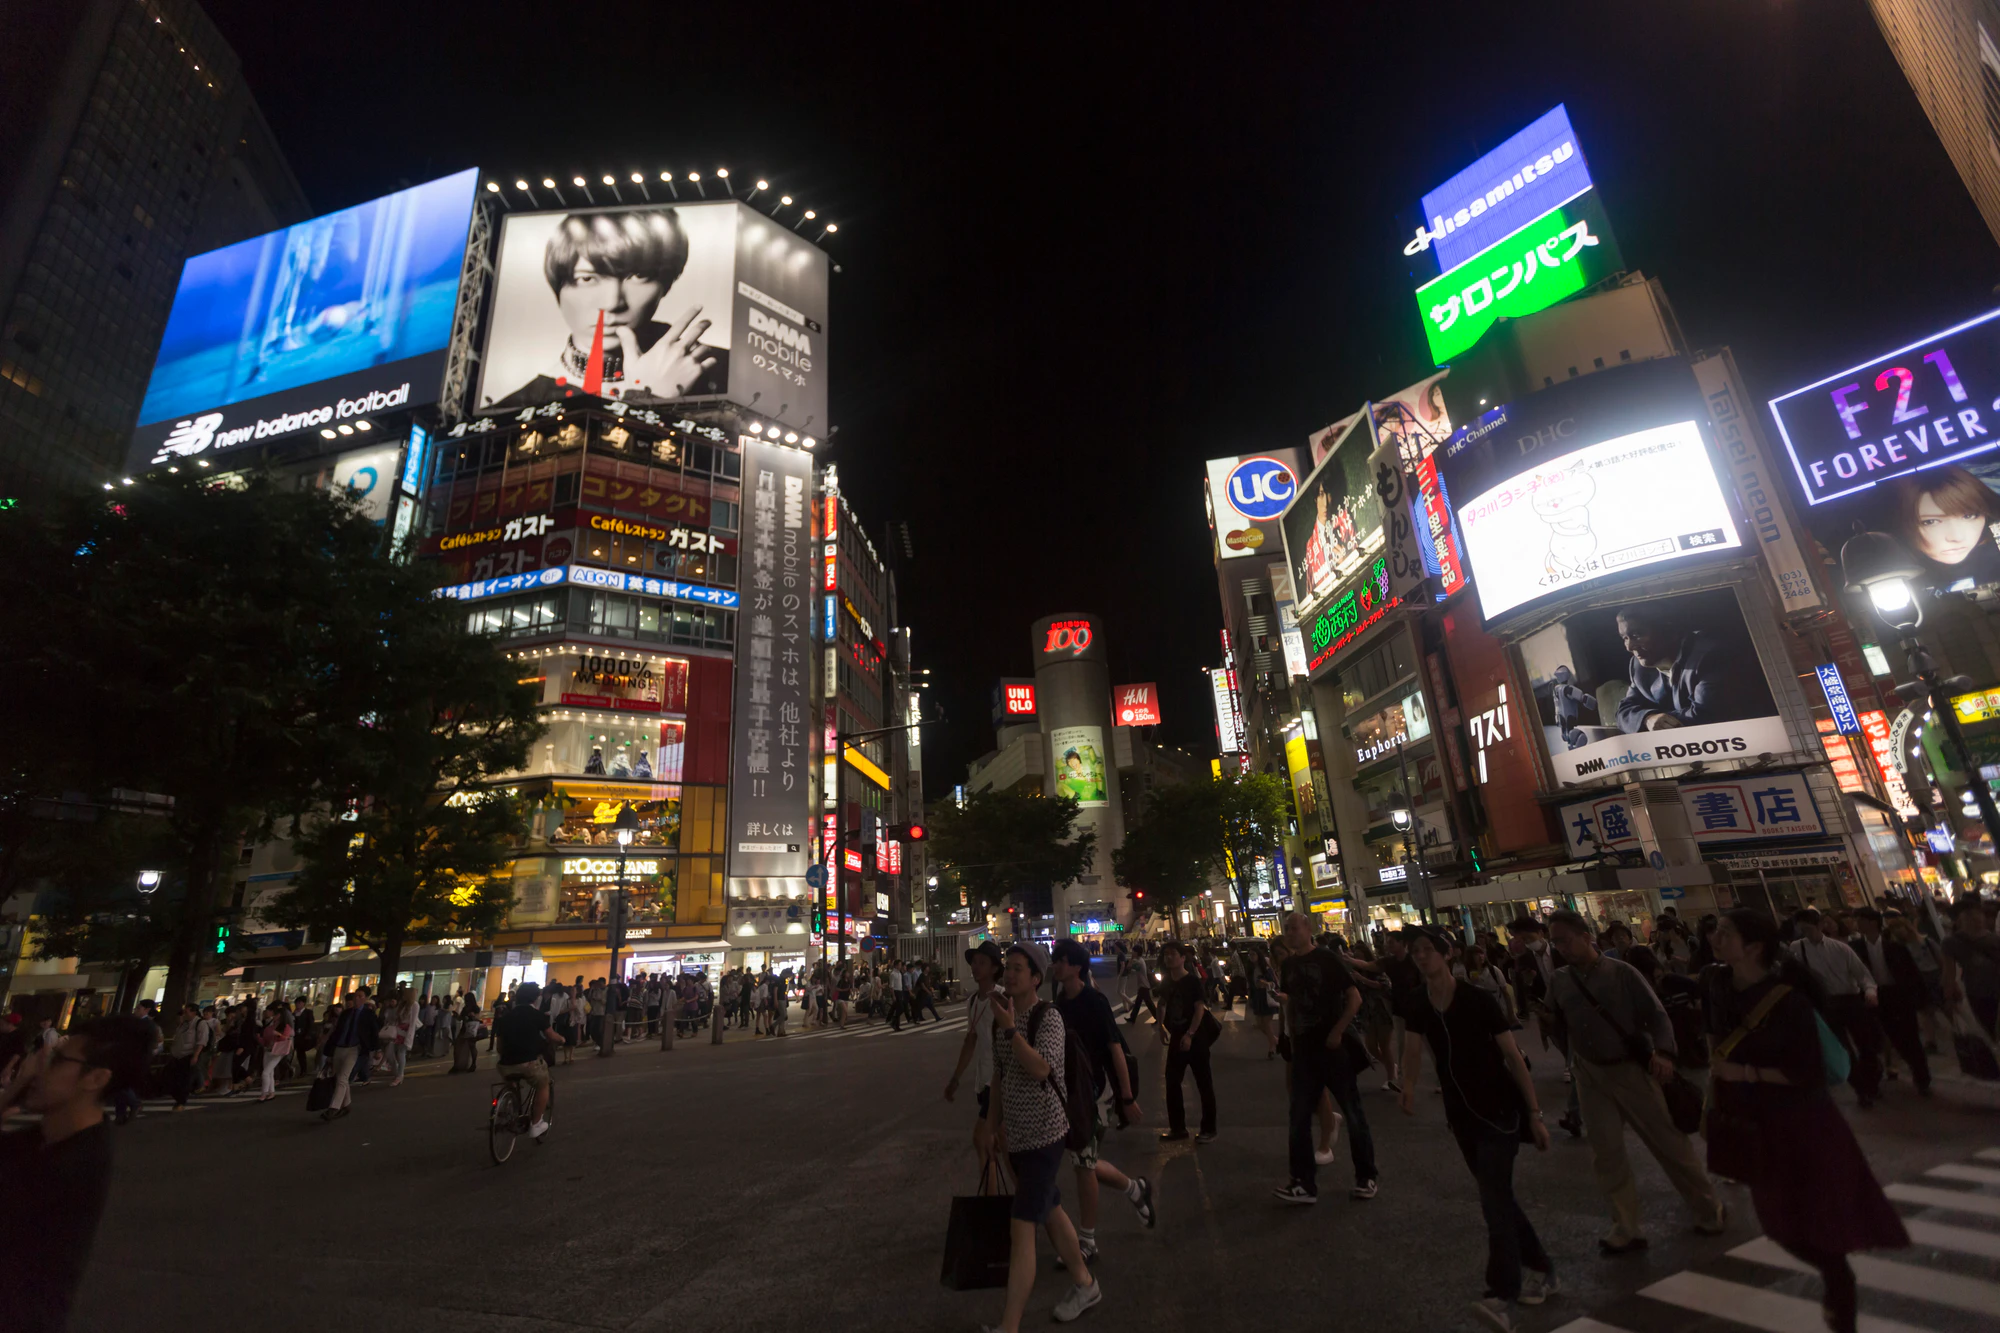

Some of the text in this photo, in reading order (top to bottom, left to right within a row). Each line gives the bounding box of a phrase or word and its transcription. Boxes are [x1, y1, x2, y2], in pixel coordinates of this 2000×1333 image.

[1404, 141, 1573, 256] Hisamitsu
[1430, 221, 1598, 331] サロンパス
[747, 331, 812, 372] mobile
[748, 306, 811, 356] DMM
[752, 354, 806, 387] のスマホ
[1830, 348, 1969, 440] F21
[214, 424, 255, 449] new
[254, 405, 333, 440] balance
[335, 382, 411, 420] football
[1447, 413, 1507, 458] DHC Channel
[1516, 417, 1577, 456] DHC
[1809, 408, 1988, 488] FOREVER
[1708, 381, 1780, 544] Taisei neon
[584, 476, 706, 518] コンタクト
[785, 475, 803, 528] DMM
[503, 514, 555, 542] ガスト
[668, 527, 725, 554] ガスト
[1226, 533, 1264, 547] MasterCard
[1377, 462, 1421, 580] もんじゃ
[1416, 462, 1456, 588] 三千里薬品
[472, 549, 535, 582] ガスト
[784, 529, 800, 588] mobile
[1538, 561, 1600, 587] くわしくは
[1689, 533, 1716, 547] 検索
[574, 568, 736, 604] AEON 英会話イーオン
[1780, 579, 1807, 592] 3719
[1784, 586, 1811, 600] 2468
[1044, 627, 1093, 656] 109
[578, 655, 652, 679] 1000%
[1008, 688, 1029, 699] UNI
[1009, 700, 1033, 712] QLO
[1123, 687, 1148, 706] H&M
[1820, 666, 1856, 733] 大盛堂商事ビル
[1217, 689, 1236, 752] Essential
[1356, 731, 1407, 762] Euphoria
[1575, 737, 1748, 777] DMM.make ROBOTS
[1890, 712, 1909, 771] 渋谷センター街
[747, 822, 794, 836] 詳しくは
[1572, 786, 1802, 847] 大盛 書店
[1762, 823, 1818, 835] BOOKS TAISEIDO
[1731, 849, 1780, 859] TAISEIDO
[913, 854, 922, 903] マルナン
